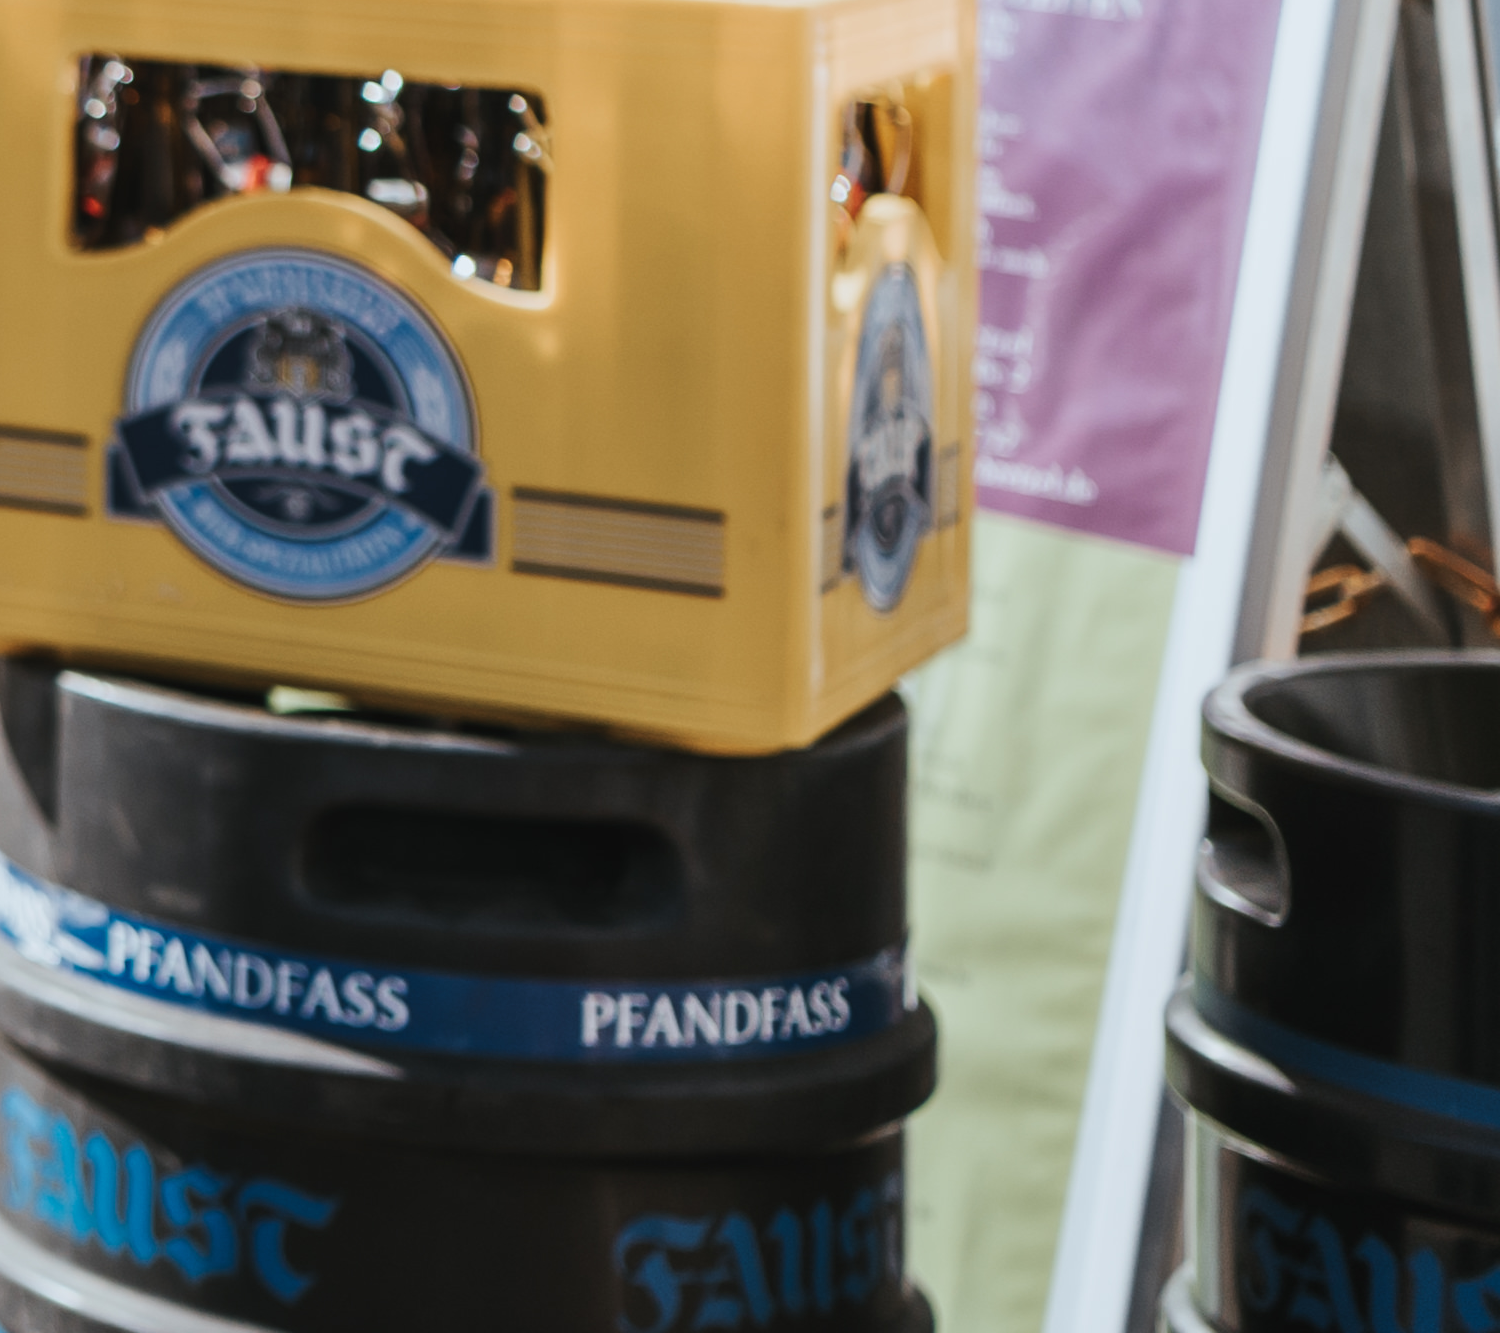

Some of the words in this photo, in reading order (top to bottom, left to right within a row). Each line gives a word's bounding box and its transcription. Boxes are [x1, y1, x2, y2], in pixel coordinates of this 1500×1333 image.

[170, 397, 438, 494] FAUST
[106, 918, 409, 1032] PFANDFASS
[580, 975, 850, 1048] PFANDFASS
[1, 1086, 338, 1303] FAUST
